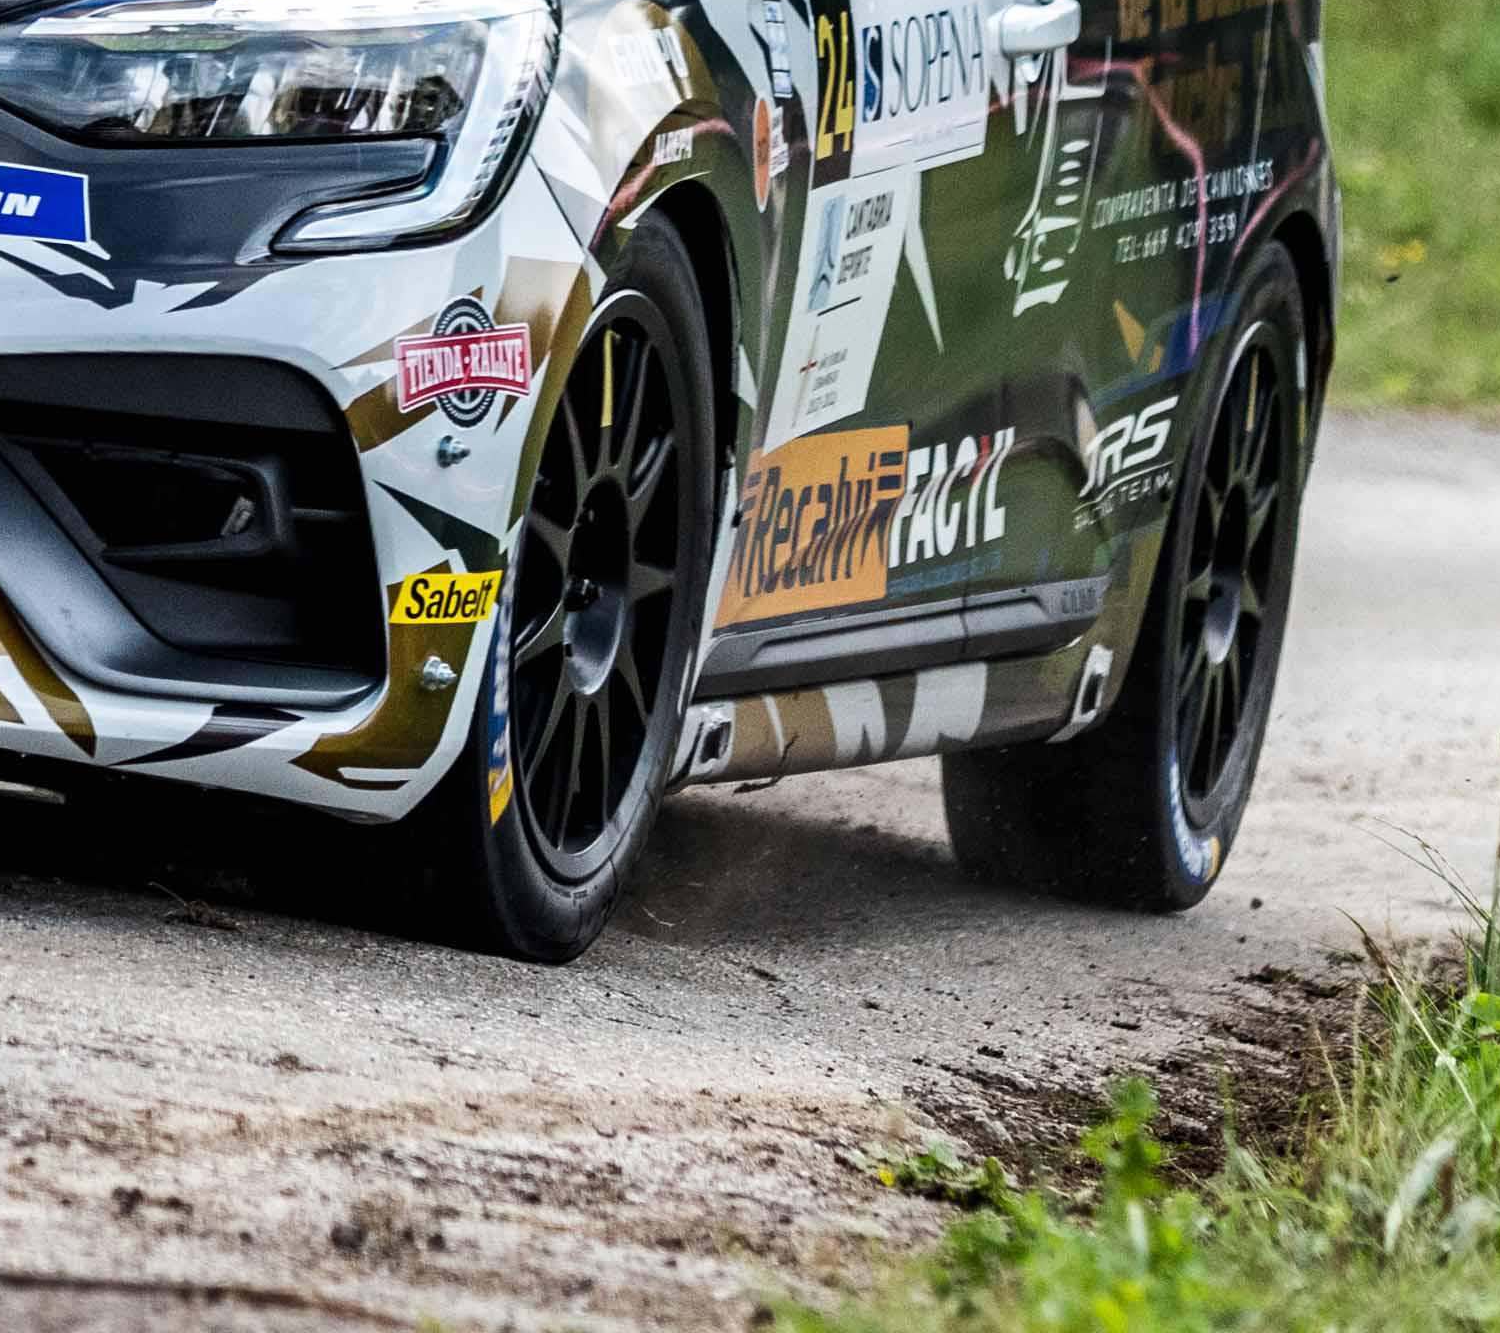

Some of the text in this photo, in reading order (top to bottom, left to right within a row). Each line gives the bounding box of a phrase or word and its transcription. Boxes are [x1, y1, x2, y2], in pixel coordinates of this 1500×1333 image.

[815, 11, 855, 161] 24
[405, 337, 525, 394] TIENDA RALLYE
[404, 577, 494, 620] Sabelt
